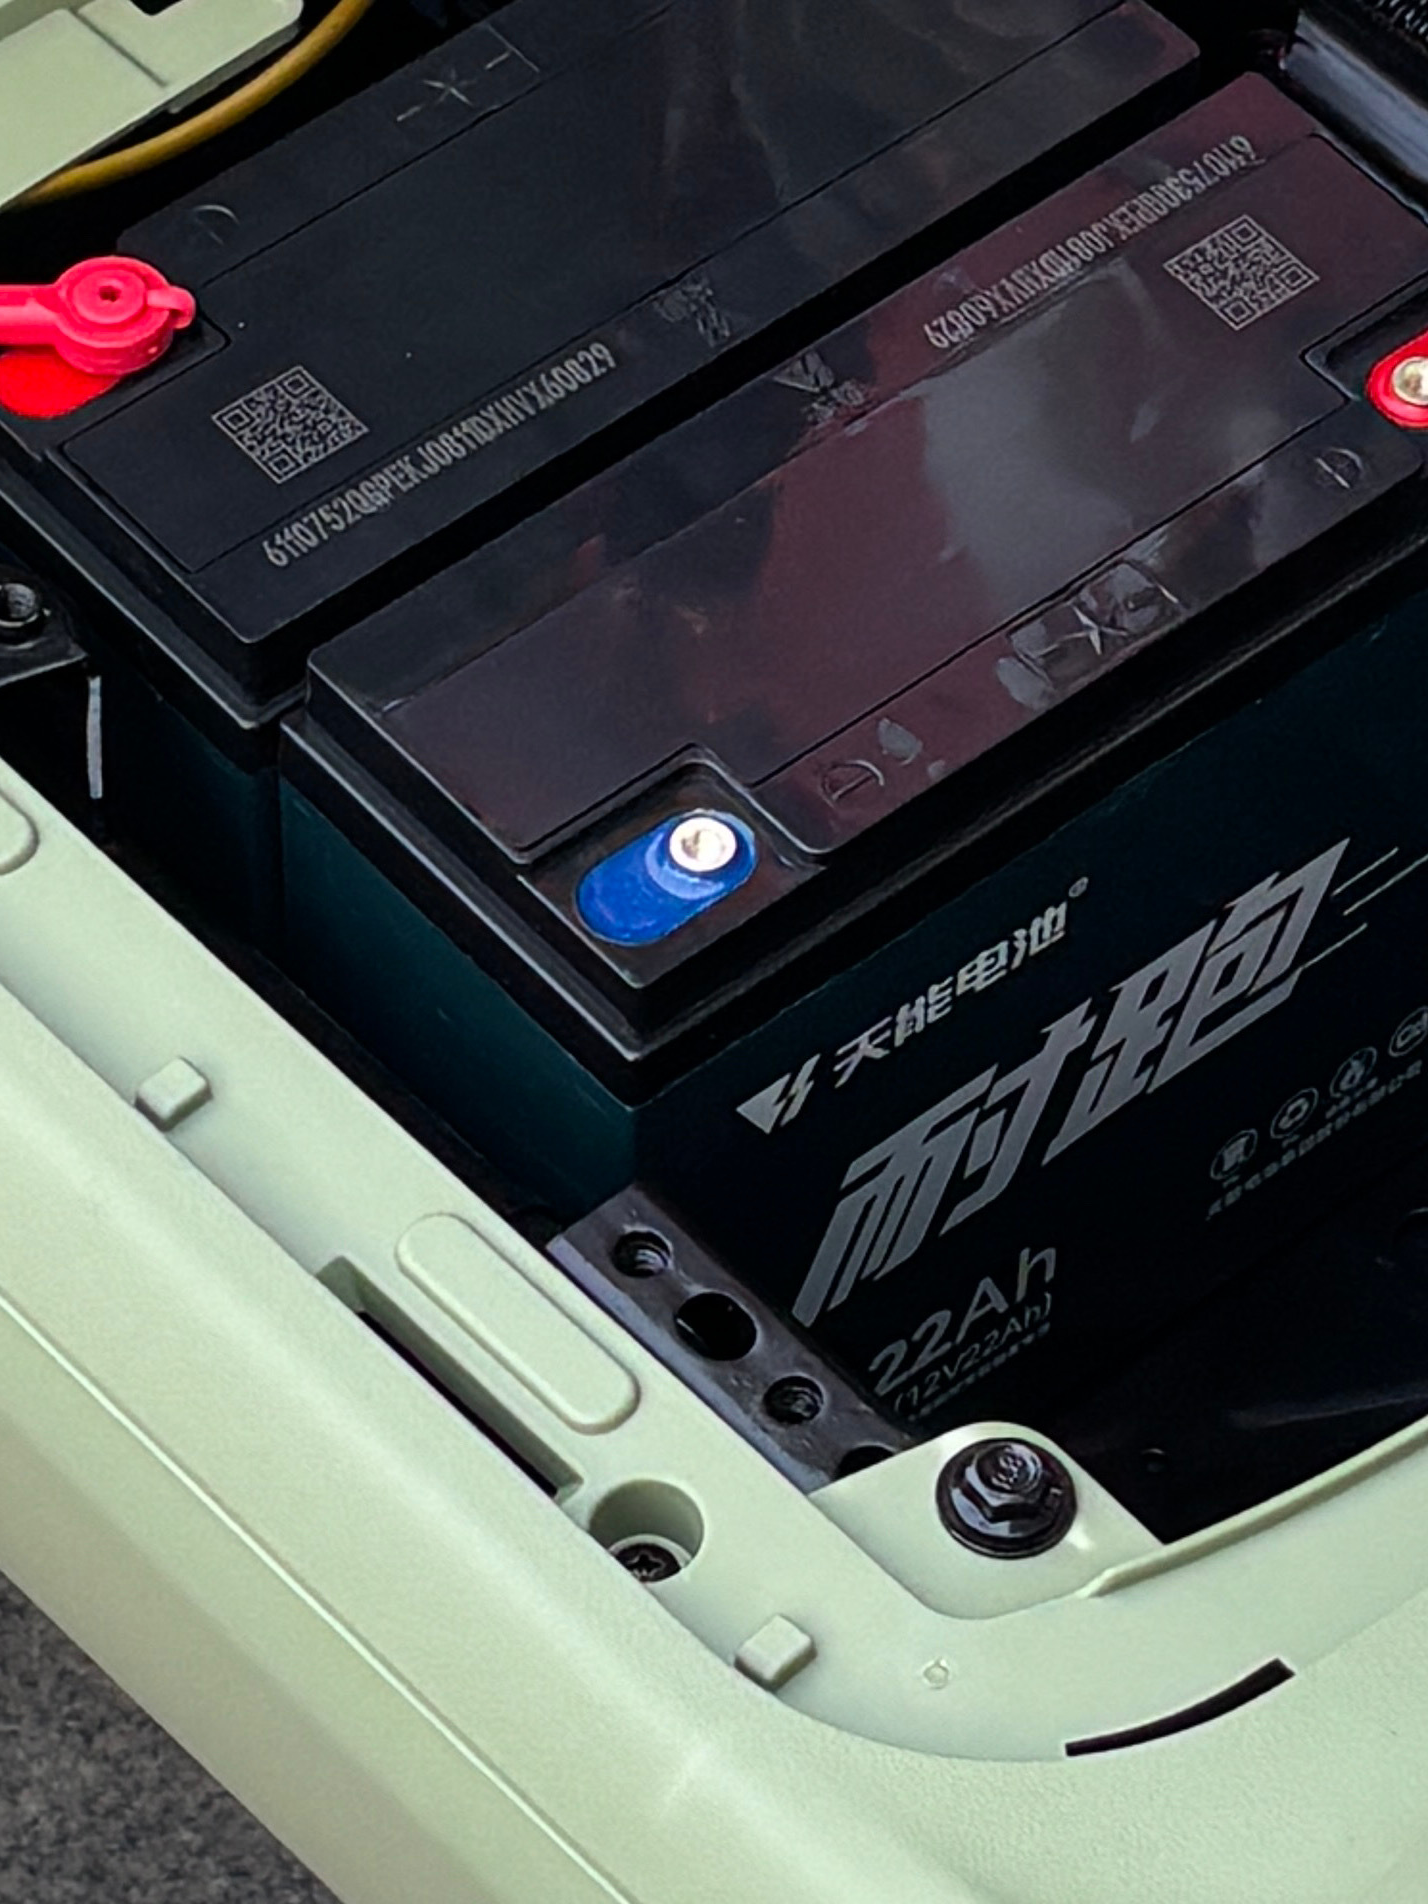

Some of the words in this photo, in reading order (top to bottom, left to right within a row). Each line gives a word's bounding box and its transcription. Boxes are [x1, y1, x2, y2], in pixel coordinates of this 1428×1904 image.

[833, 904, 1069, 1089] 天能电池
[868, 1246, 1057, 1396] 22Ah
[894, 1291, 1052, 1413] (12V22Ah)
